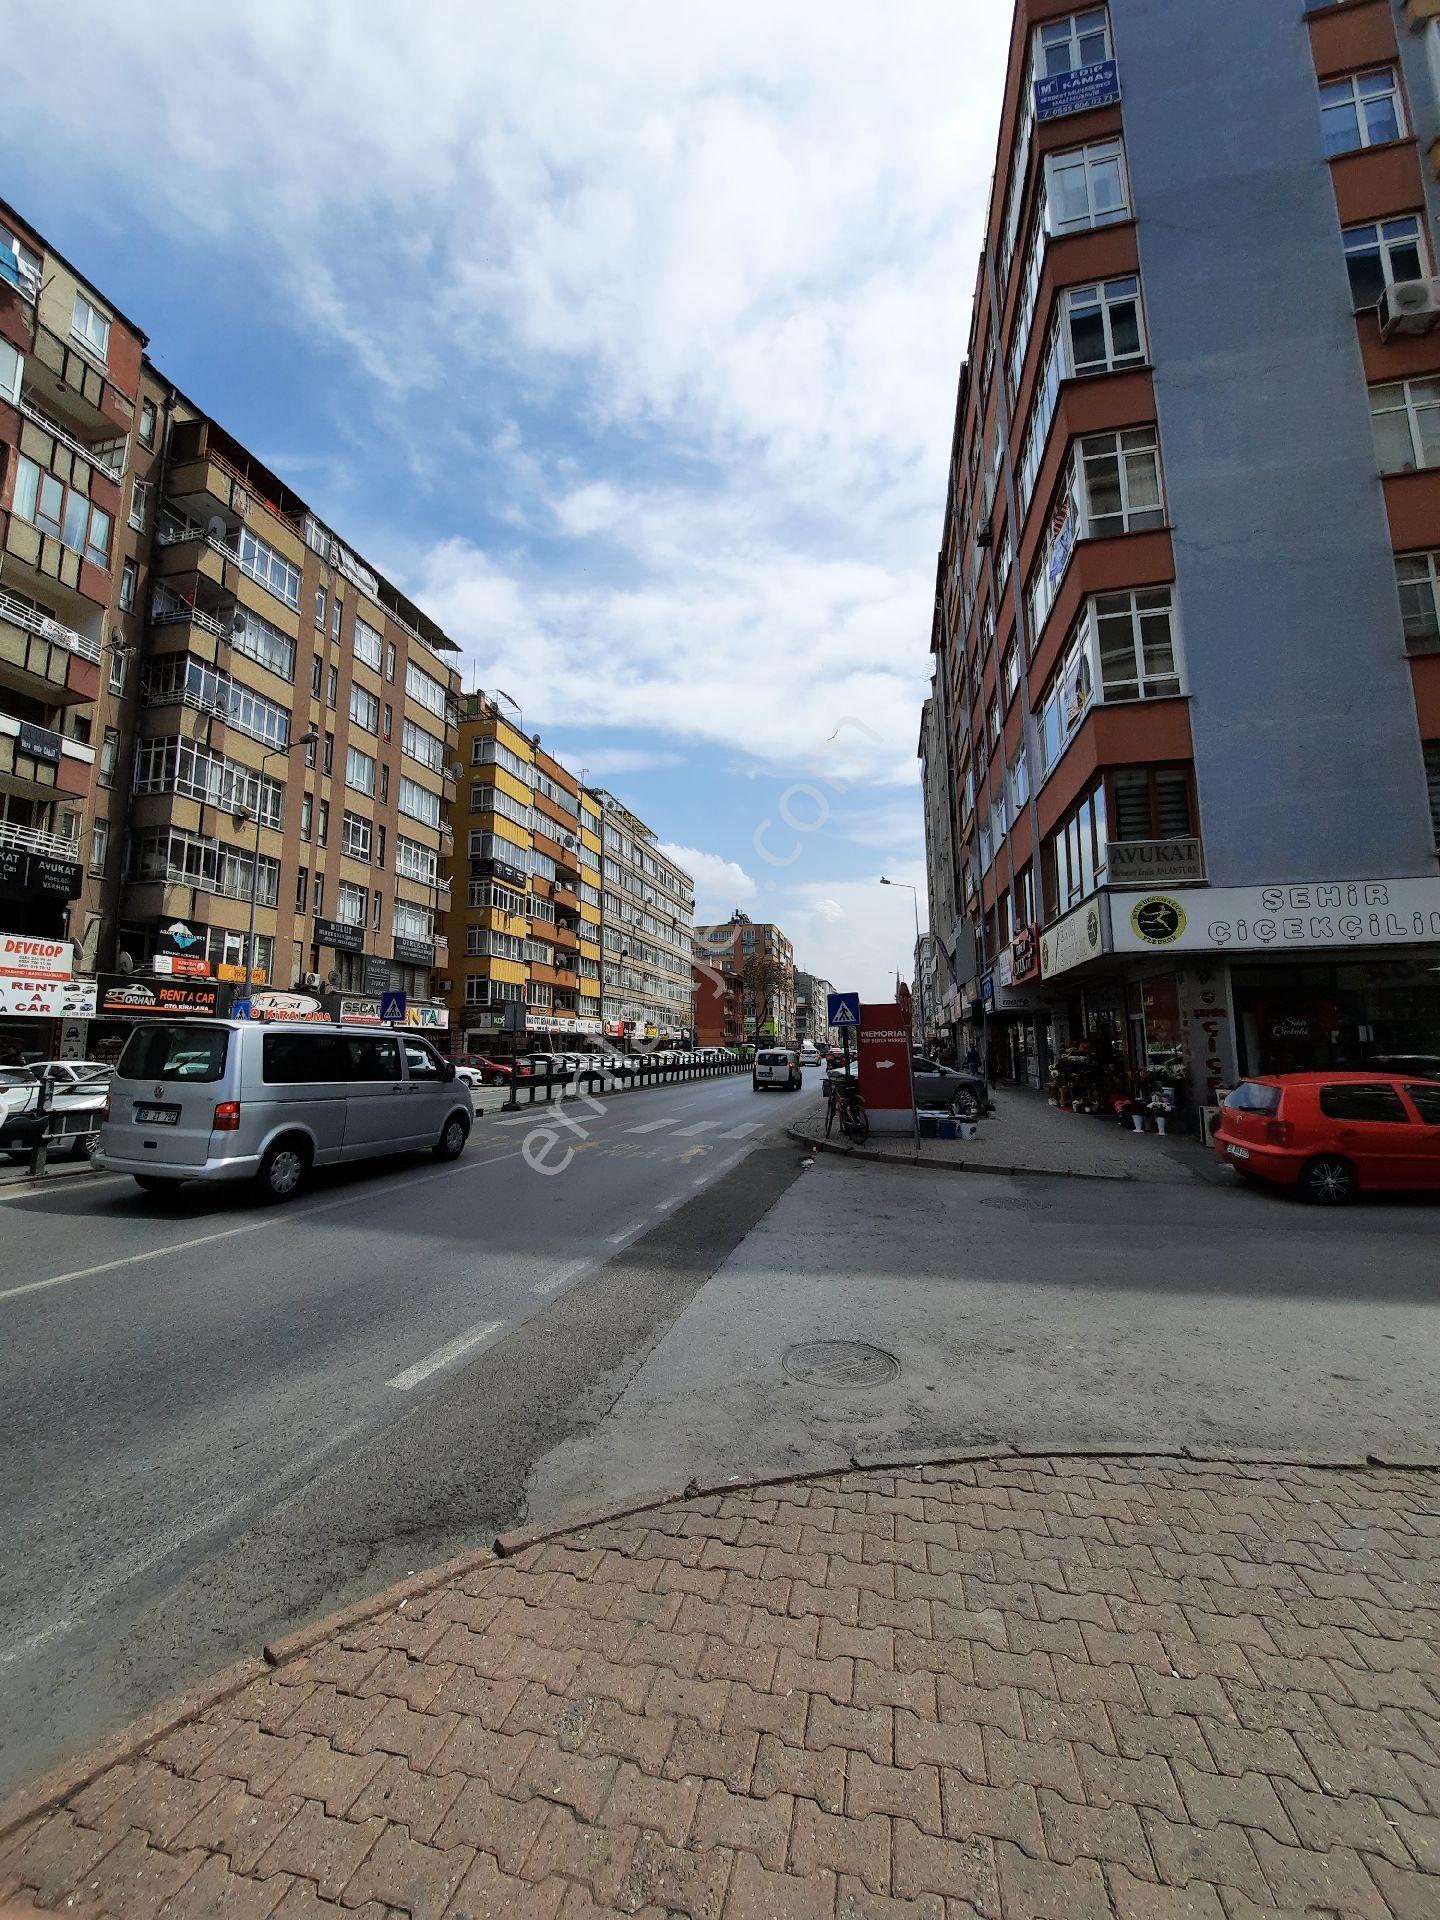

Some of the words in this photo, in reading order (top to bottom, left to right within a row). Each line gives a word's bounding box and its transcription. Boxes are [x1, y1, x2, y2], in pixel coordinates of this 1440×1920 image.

[1112, 843, 1197, 864] AVUKAT
[39, 861, 77, 876] AVUKAT
[1262, 884, 1390, 913] ŞEHİR
[4, 939, 64, 958] DEVELOP
[11, 981, 58, 992] RENT
[30, 993, 42, 1001] A
[124, 995, 156, 1006] ORHAN
[160, 989, 186, 1002] RENT
[187, 992, 194, 1002] A
[195, 992, 215, 1004] CAR
[15, 1002, 51, 1012] CAR
[264, 1009, 331, 1021] KİRALAMA
